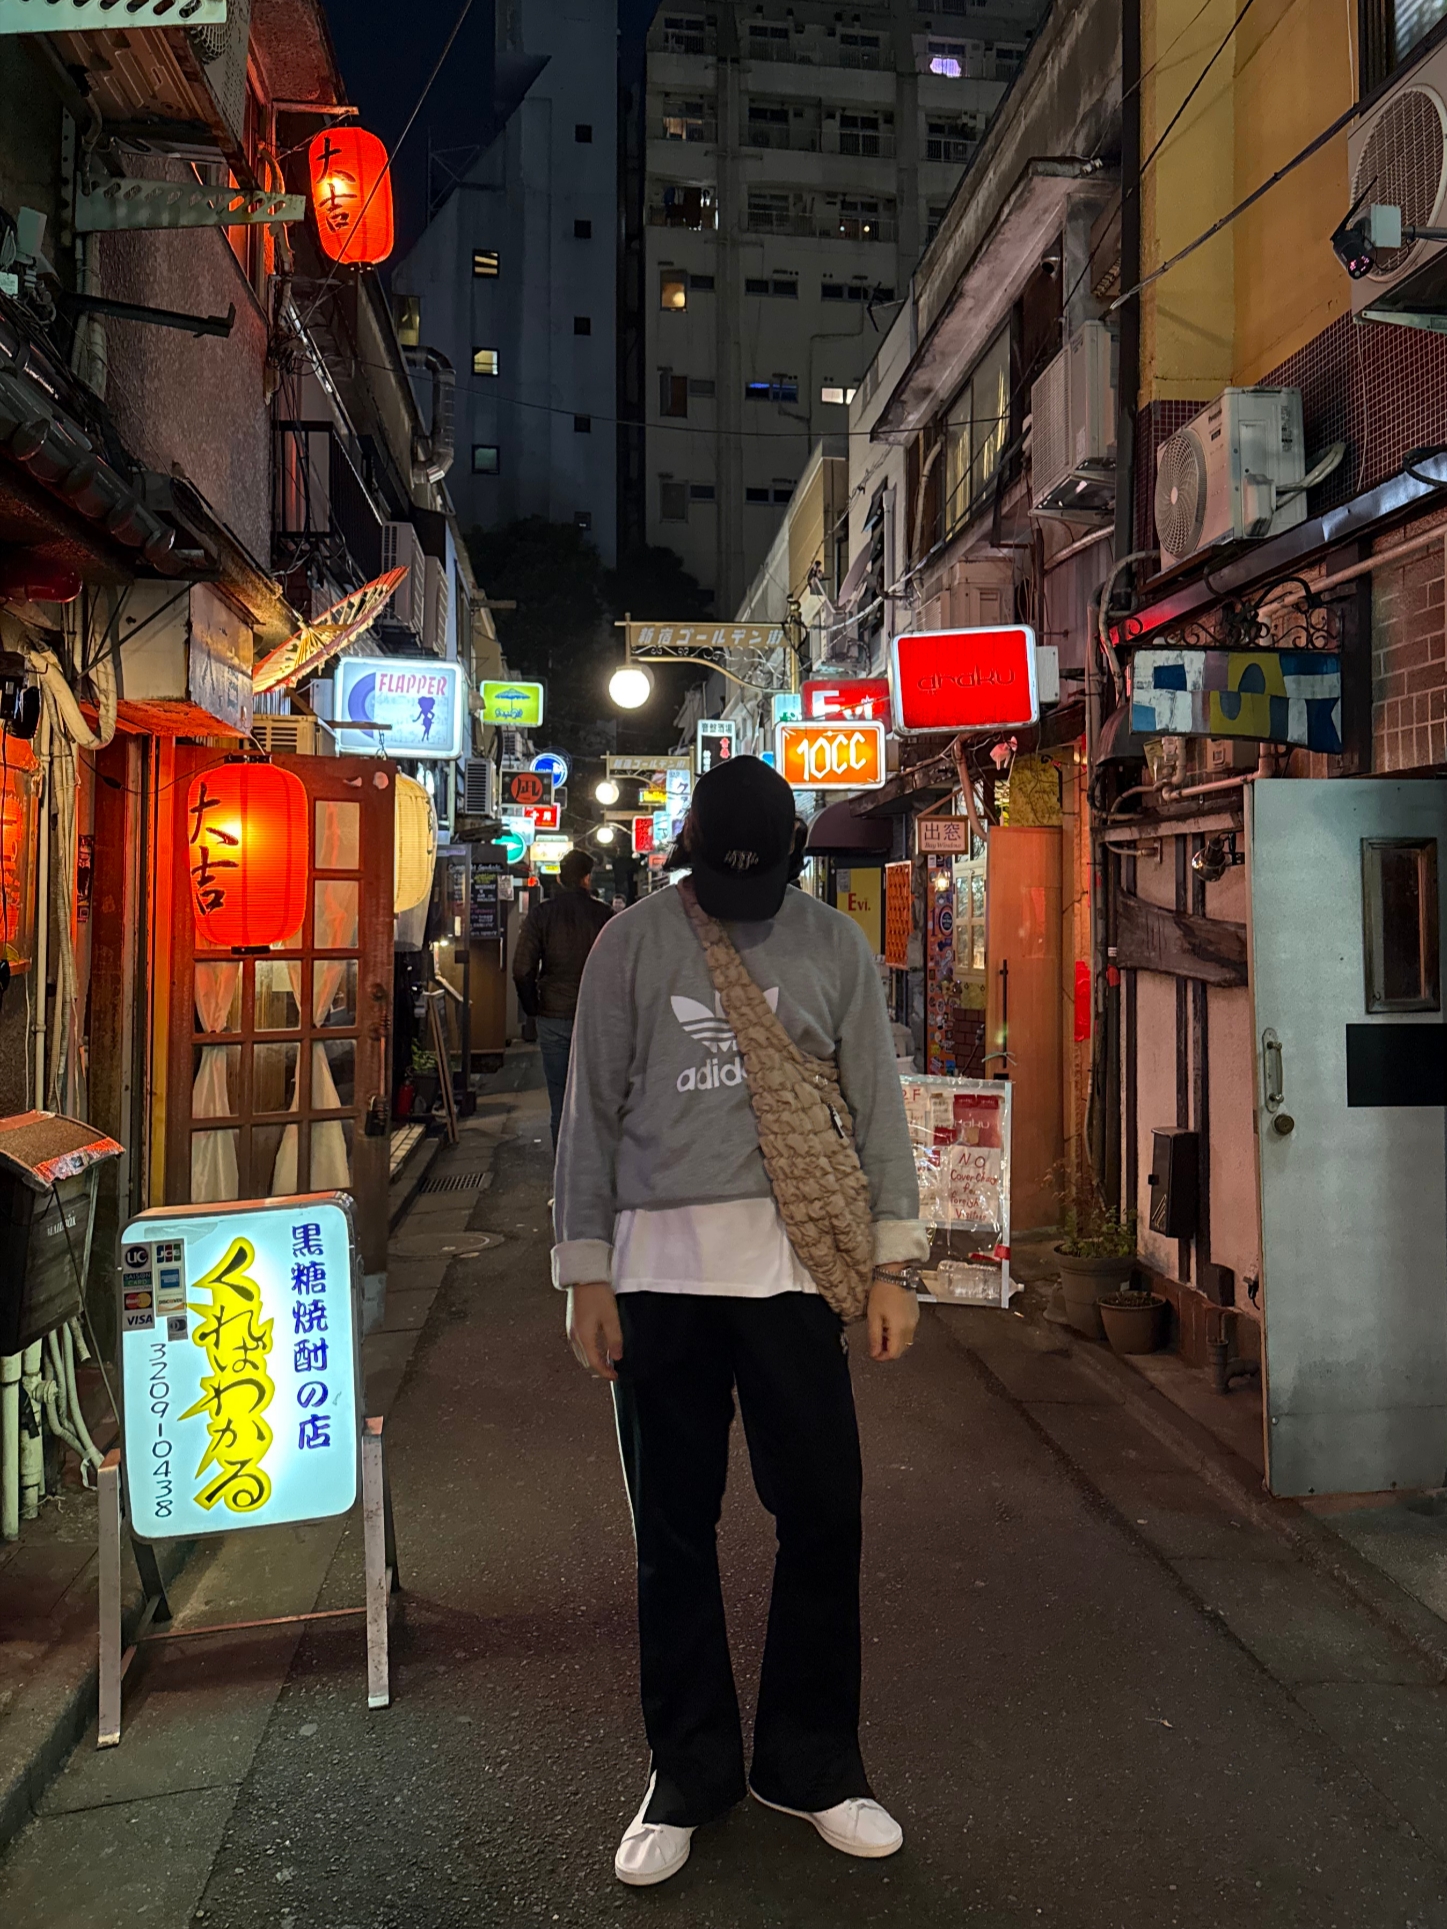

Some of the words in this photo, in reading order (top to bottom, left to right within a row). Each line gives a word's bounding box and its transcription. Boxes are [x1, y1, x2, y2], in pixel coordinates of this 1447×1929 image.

[315, 137, 358, 233] 大吉
[637, 627, 785, 646] 新宿ゴールデン街
[378, 673, 448, 696] FLAPPER
[924, 822, 961, 842] 出窓
[189, 781, 239, 916] 大吉
[126, 1250, 148, 1264] UC
[157, 1246, 181, 1261] JCB
[127, 1314, 153, 1326] VISA
[291, 1223, 331, 1450] 黒糖焼酎の店
[199, 1245, 268, 1509] くればわかる
[149, 1342, 174, 1519] 3209-0438
